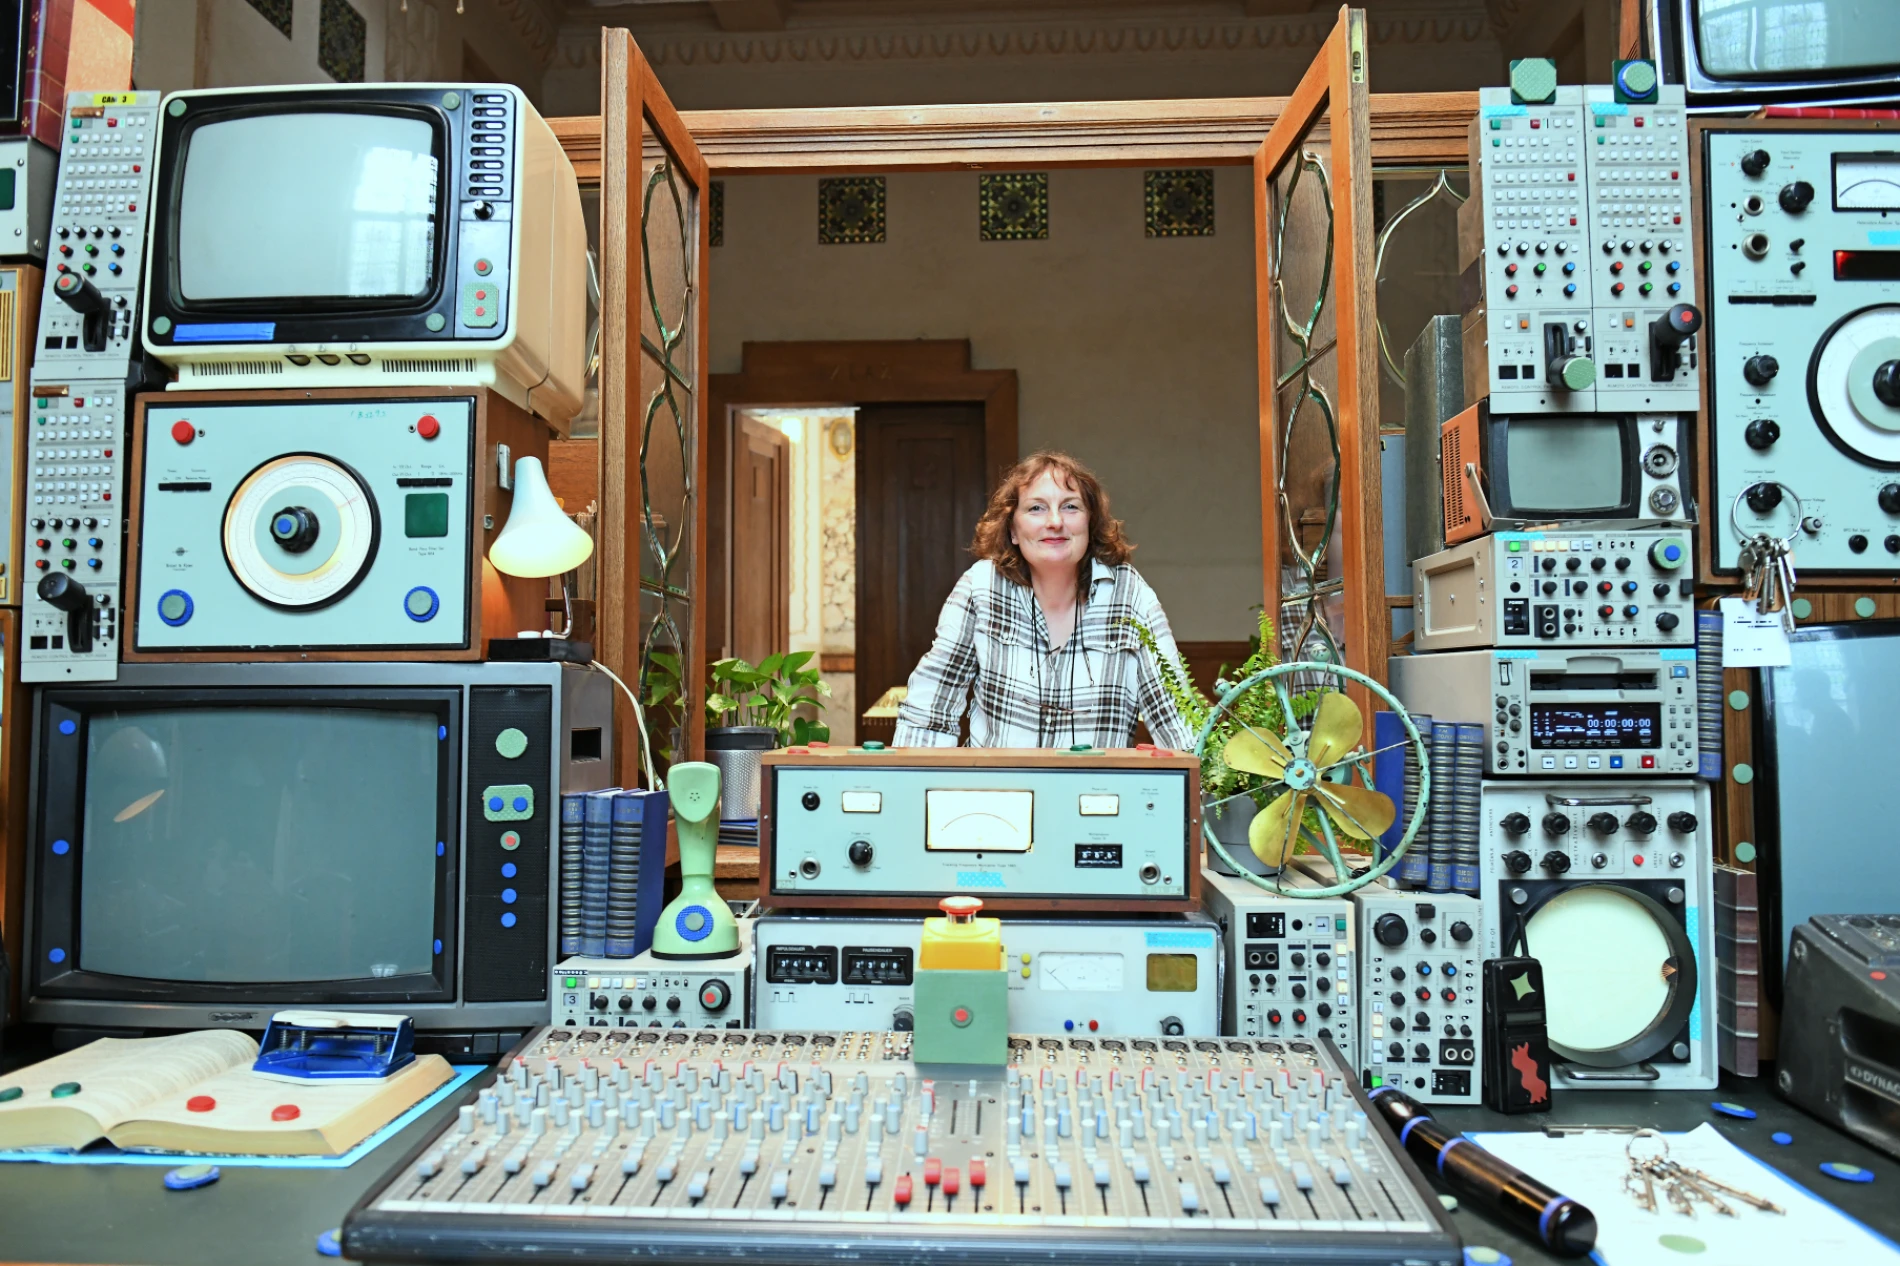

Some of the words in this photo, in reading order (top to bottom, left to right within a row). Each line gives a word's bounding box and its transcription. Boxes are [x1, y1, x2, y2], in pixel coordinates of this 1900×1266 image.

[101, 95, 117, 103] CAM
[122, 95, 127, 103] 3
[1511, 559, 1518, 569] 2
[1588, 718, 1651, 728] 00:00:00:00
[569, 995, 576, 1004] 3
[1390, 1077, 1399, 1085] 4
